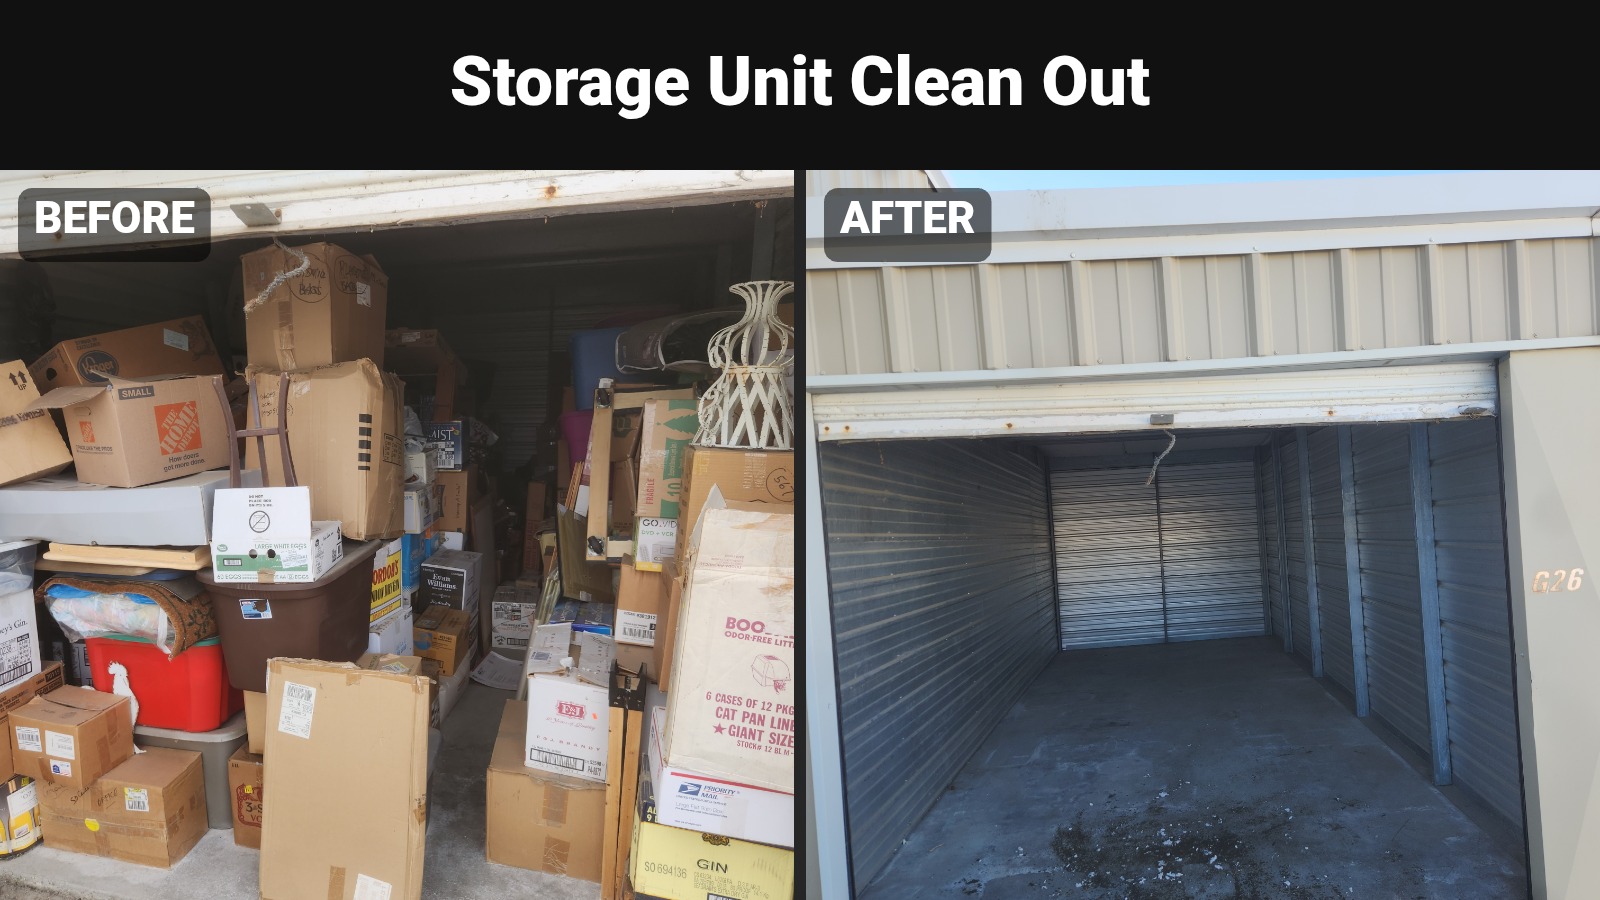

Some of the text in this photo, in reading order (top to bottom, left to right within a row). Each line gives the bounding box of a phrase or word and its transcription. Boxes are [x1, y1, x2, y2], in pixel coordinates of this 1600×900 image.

[82, 356, 115, 375] Kroger
[17, 383, 27, 391] UP
[121, 388, 152, 398] SMALL
[162, 409, 179, 431] THE
[160, 401, 198, 455] HOME
[178, 418, 201, 451] DEPOT
[168, 452, 200, 463] How doers
[163, 465, 174, 473] got
[174, 461, 190, 470] more
[645, 478, 655, 505] FRAGILE
[666, 482, 681, 497] 10
[642, 518, 678, 529] GO.VID
[372, 559, 399, 585] ORDON'S
[432, 573, 451, 582] Evan
[1532, 568, 1585, 593] G26
[725, 616, 772, 635] BOO
[774, 638, 794, 649] LITT
[705, 691, 712, 701] 6
[715, 693, 743, 706] CASES
[745, 698, 758, 709] OF
[761, 701, 773, 712] 12
[715, 706, 738, 721] CAT
[741, 711, 766, 727] PAN
[728, 724, 794, 749] GIANT SIZE
[764, 745, 773, 753] 12
[700, 792, 718, 800] MAIL
[703, 785, 736, 796] PRIORITY
[657, 863, 687, 878] 694136
[696, 858, 728, 874] GIN
